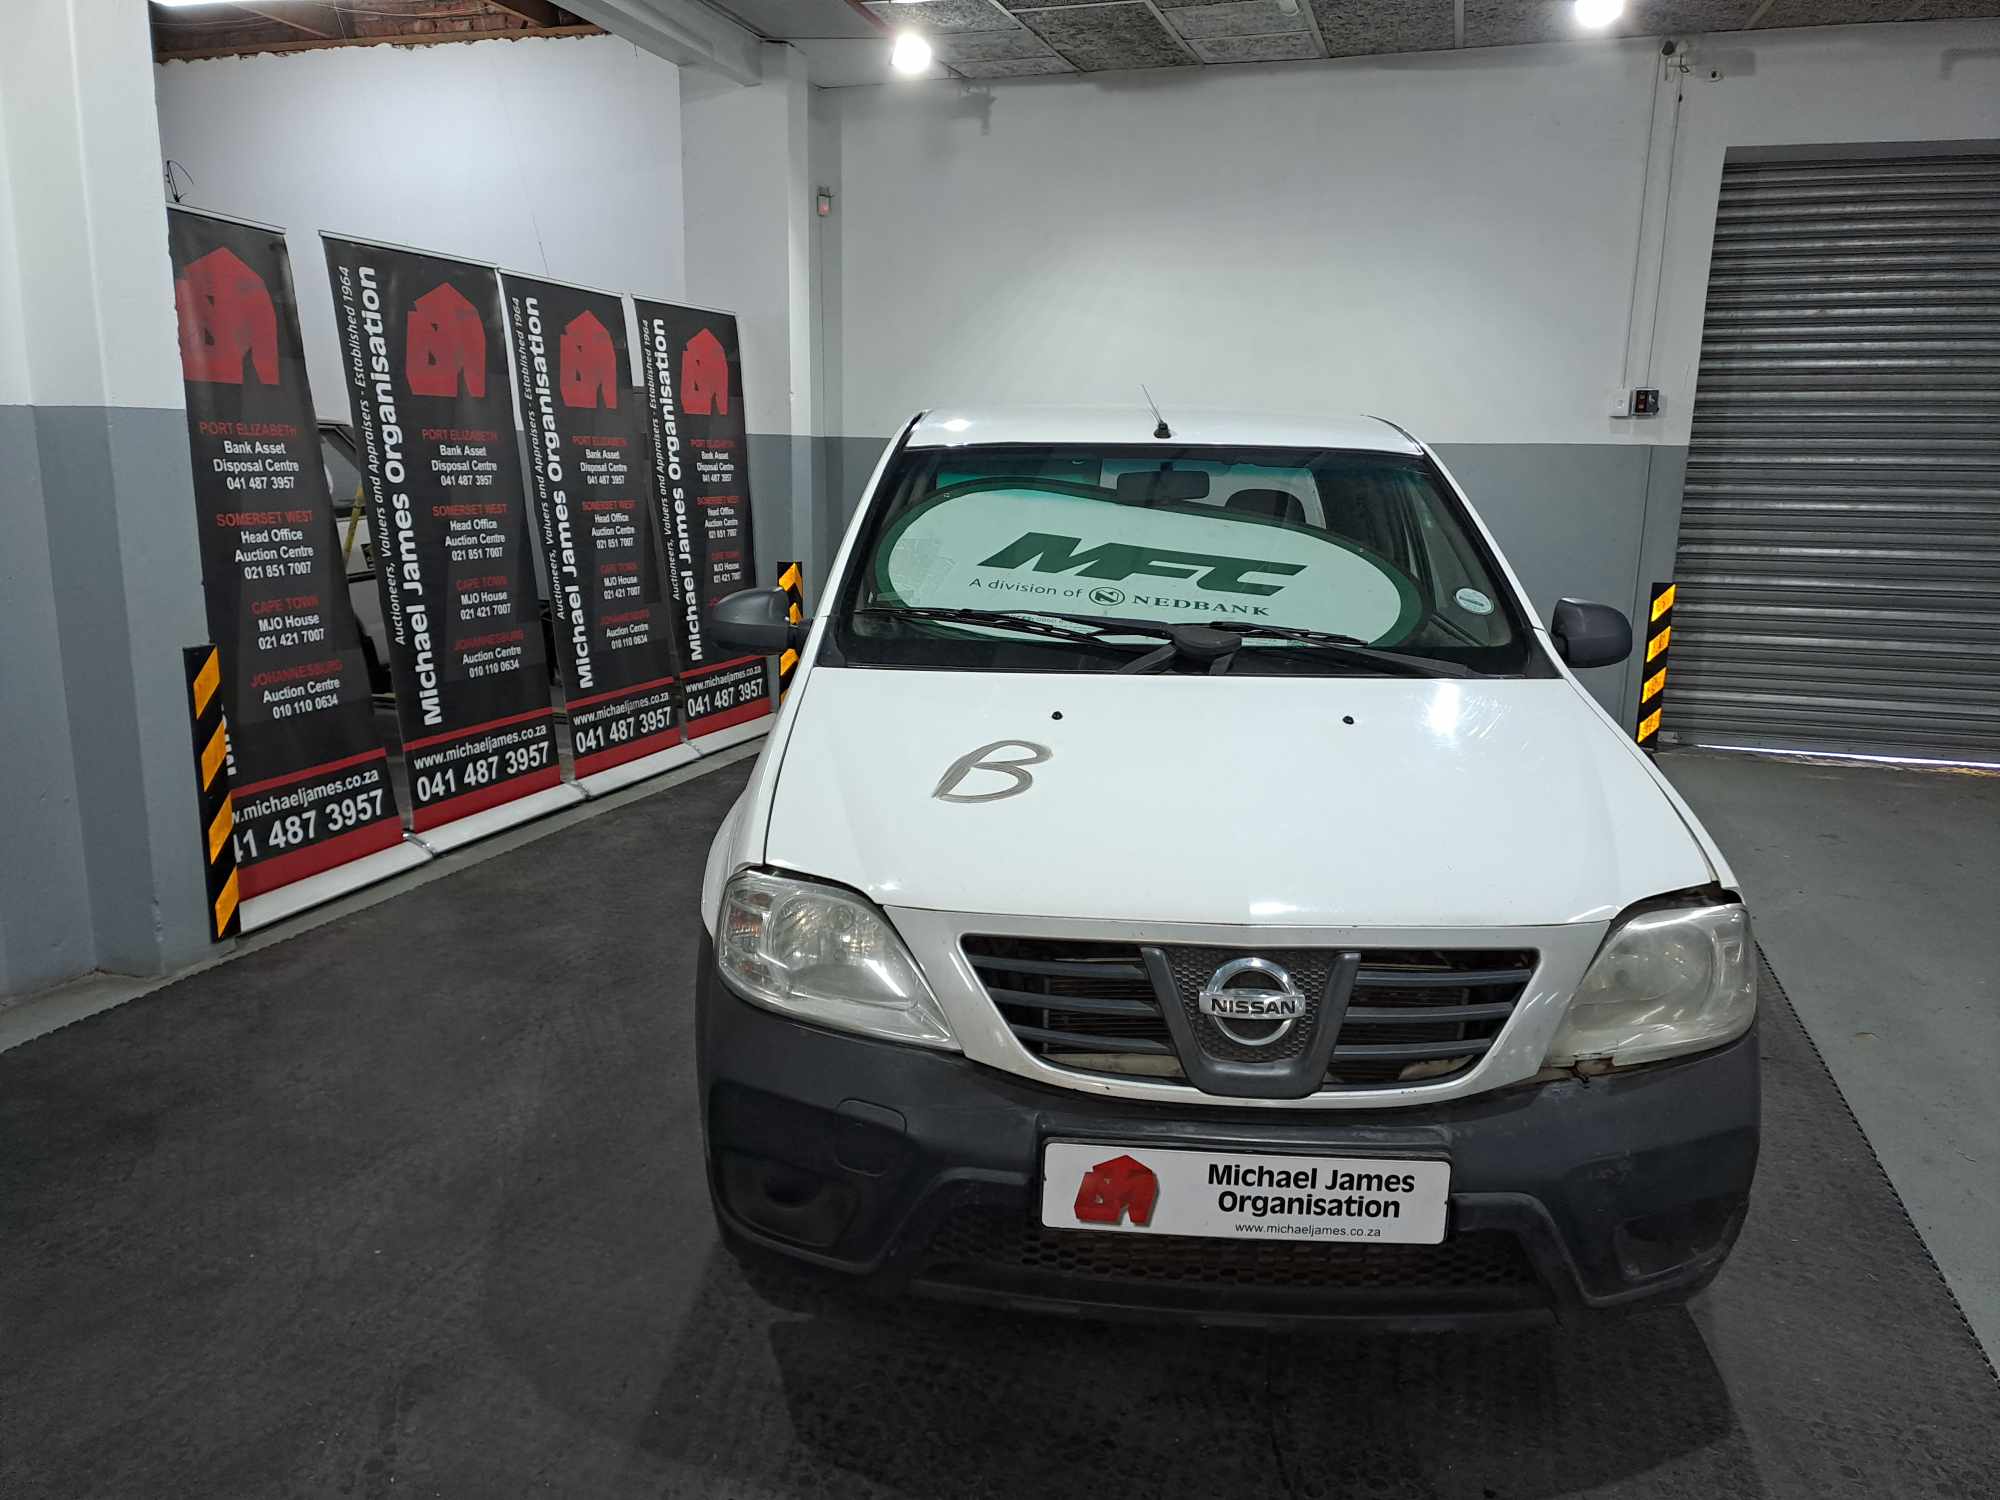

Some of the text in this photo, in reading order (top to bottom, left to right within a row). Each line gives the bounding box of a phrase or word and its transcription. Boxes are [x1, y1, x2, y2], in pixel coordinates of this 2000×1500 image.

[338, 265, 353, 302] 1964
[346, 305, 367, 388] Established
[517, 331, 533, 400] Established
[200, 421, 233, 435] PORT
[360, 399, 379, 474] Appraisers
[527, 410, 543, 473] Appraisers
[223, 440, 287, 454] Bank Asset
[440, 445, 487, 456] Bank Asset
[652, 418, 665, 473] Appraisers
[213, 458, 299, 474] Disposal Centre
[431, 460, 497, 473] Disposal Centre
[226, 476, 294, 490] 041 487 3957
[370, 476, 384, 504] and
[441, 476, 455, 486] 041
[458, 475, 472, 486] 487
[525, 297, 594, 689] Michael James Organisation
[536, 475, 547, 499] and
[653, 318, 703, 661] Michael James Organisation
[657, 475, 667, 496] and
[358, 266, 443, 726] Michael James Organisation
[216, 510, 313, 527] SOMERSET WEST
[450, 518, 497, 531] Head Office
[541, 502, 554, 545] Valuers
[661, 497, 672, 536] Valuers
[240, 528, 303, 544] Head Office
[376, 507, 392, 557] Valuers
[445, 533, 505, 547] Auction Centre
[235, 545, 314, 563] Auction Centre
[452, 550, 466, 561] 021
[468, 548, 482, 560] 851
[976, 532, 1307, 597] MFC
[244, 561, 312, 580] 021 851 7007
[385, 562, 406, 645] Auctioneers,
[461, 590, 507, 605] MJO House
[969, 578, 982, 589] A
[988, 578, 1057, 595] division
[1063, 588, 1083, 598] of
[1133, 595, 1270, 616] NEDBANK
[258, 613, 320, 632] MJO House
[460, 603, 511, 620] 021 421 7007
[258, 628, 325, 650] 021 421 7007
[462, 645, 521, 665] Auction Centre
[469, 659, 520, 678] 010 110 0634
[263, 678, 341, 703] Auction Centre
[687, 678, 763, 718] 041 487 3957
[272, 694, 339, 720] 010 110 0634
[573, 691, 669, 726] www.michaeljames.co.za
[576, 706, 671, 754] 041 487 3957
[414, 724, 546, 770] www.michaeljames.co.za
[416, 741, 549, 802] 041 487 3957
[931, 738, 1053, 803] B
[232, 769, 380, 825] w.michaeljames.co.za
[268, 811, 317, 849] 487
[325, 789, 384, 832] 3957
[1210, 998, 1296, 1015] NISSAN
[1208, 1163, 1415, 1192] Michael James
[1217, 1190, 1400, 1219] Organisation
[1234, 1222, 1381, 1239] www.michaeljames.co.za
